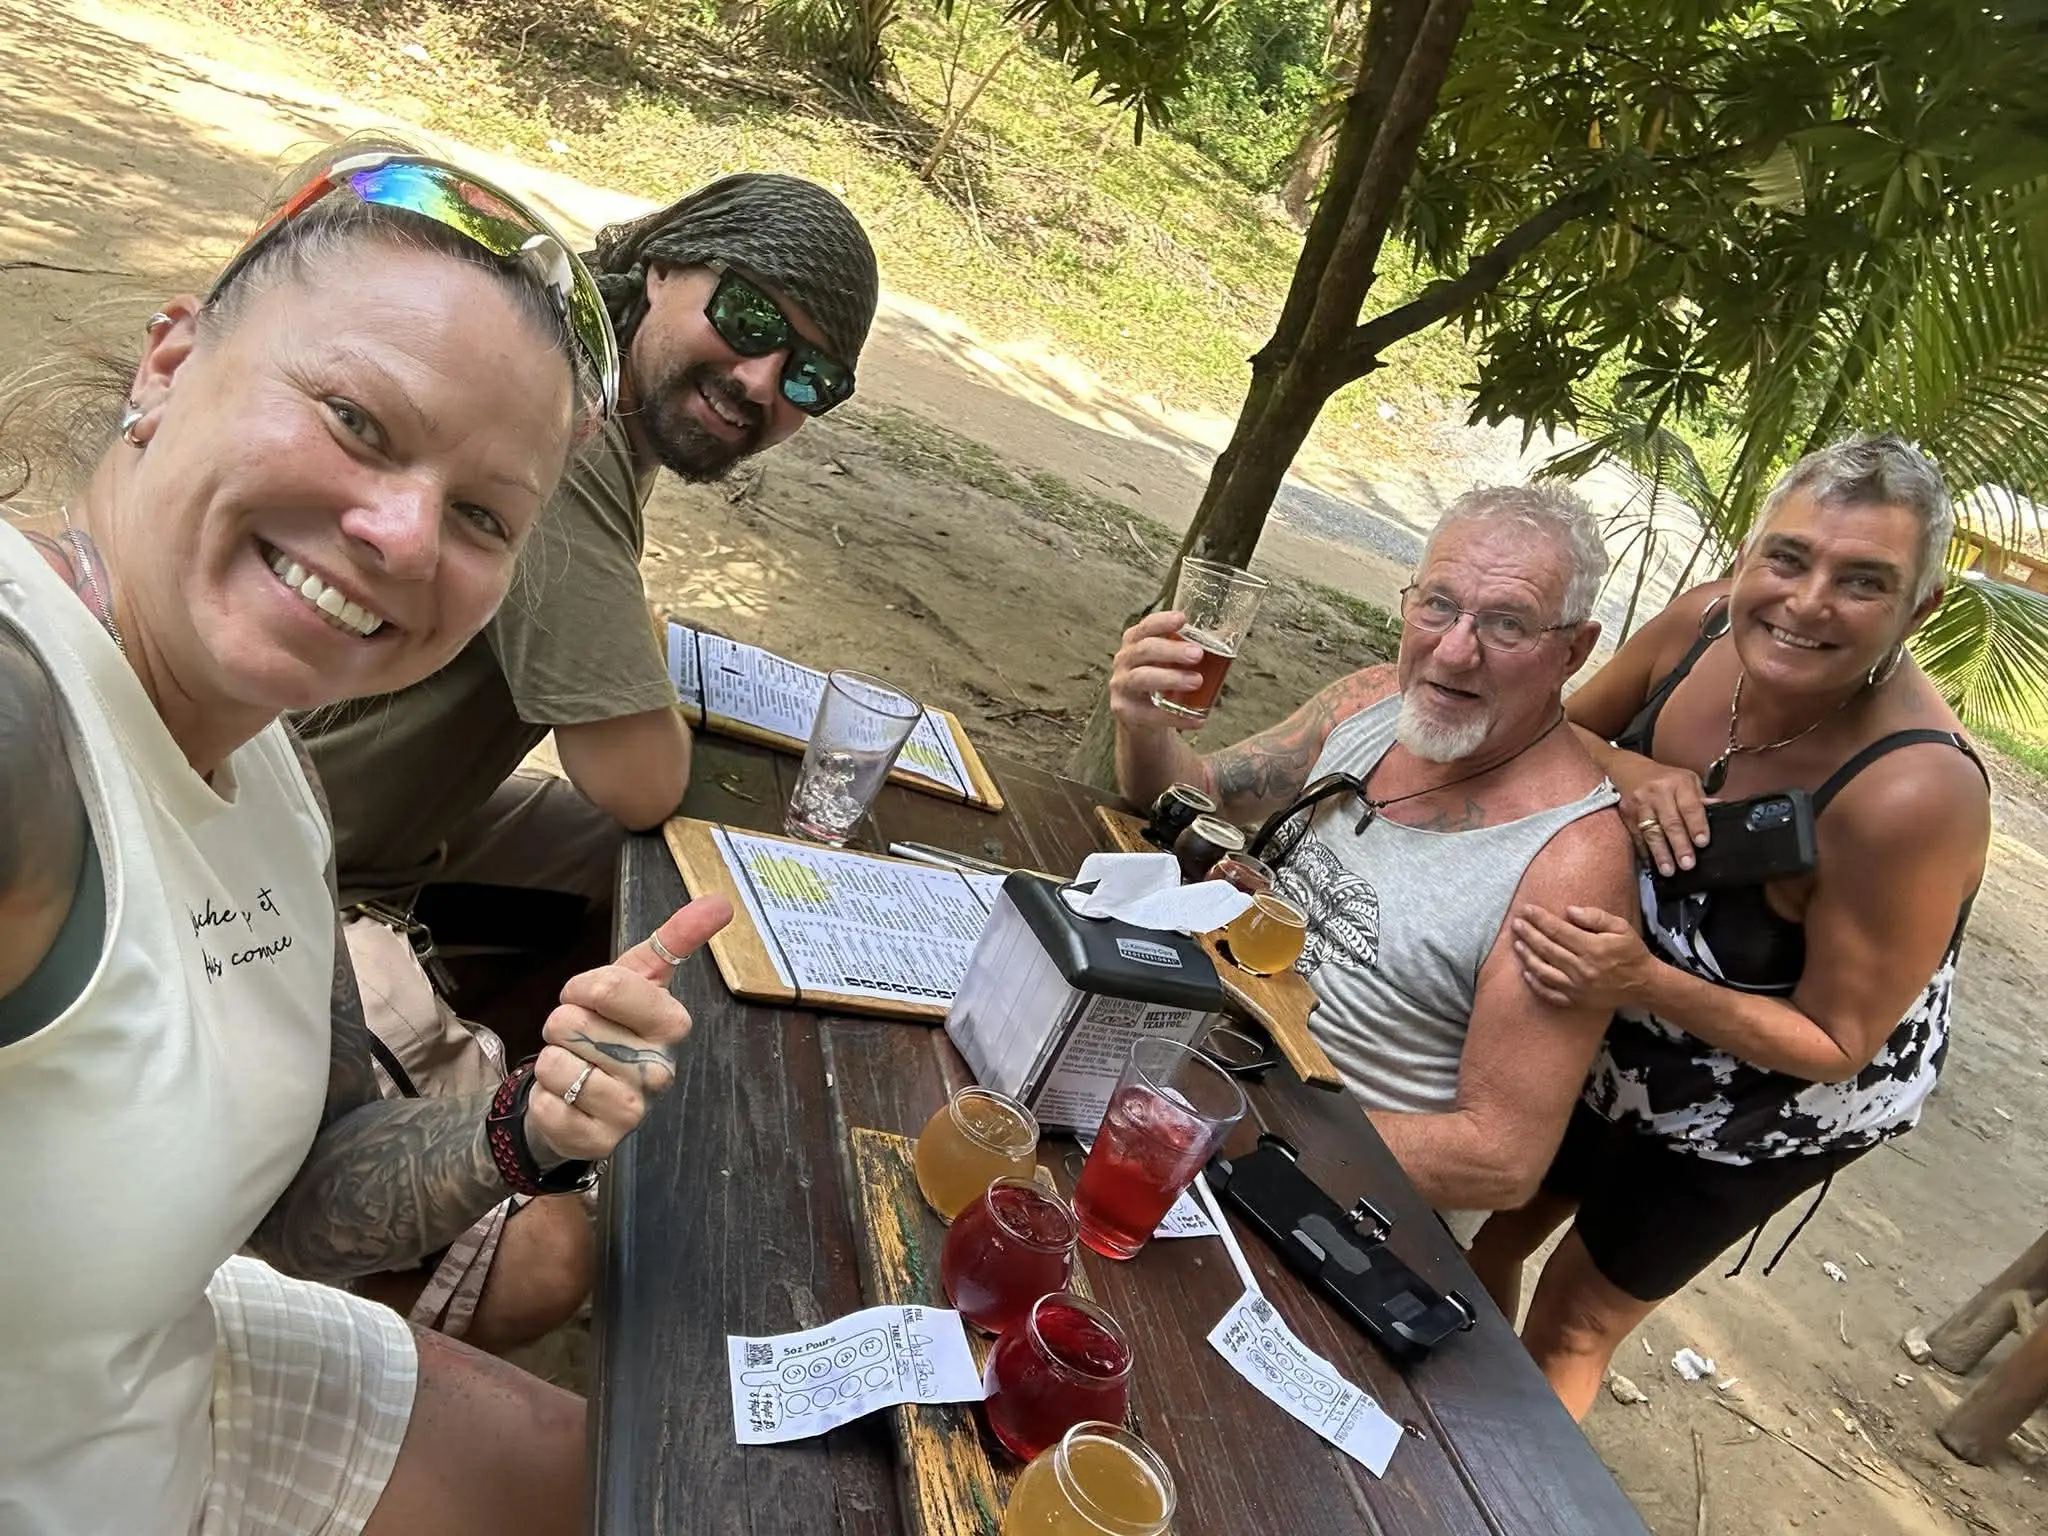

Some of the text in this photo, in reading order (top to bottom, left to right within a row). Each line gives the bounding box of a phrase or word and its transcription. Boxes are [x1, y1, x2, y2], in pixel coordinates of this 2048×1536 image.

[256, 887, 281, 917] et
[1145, 1011, 1168, 1021] HEY
[805, 1335, 837, 1352] Pours
